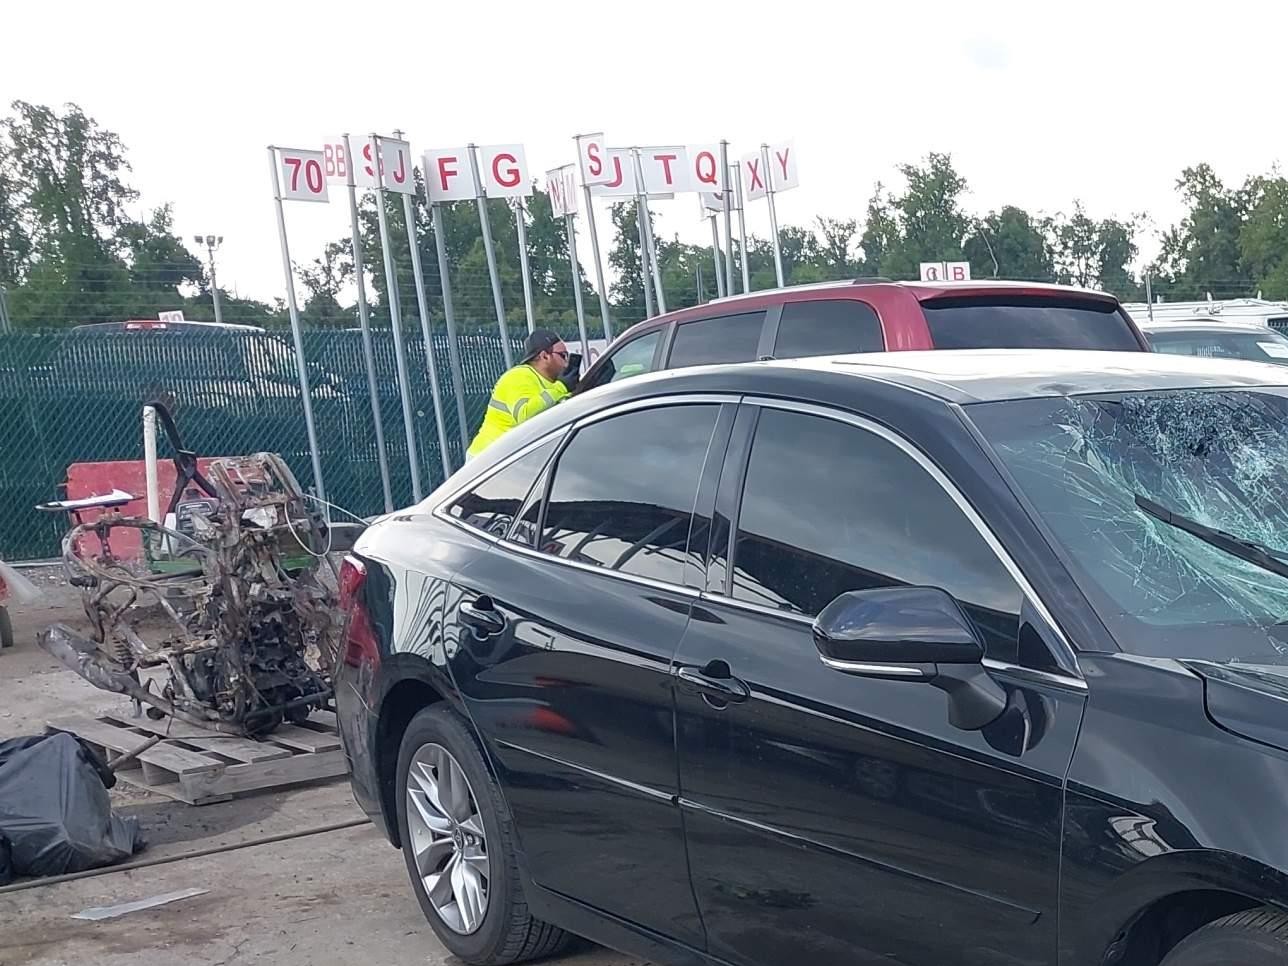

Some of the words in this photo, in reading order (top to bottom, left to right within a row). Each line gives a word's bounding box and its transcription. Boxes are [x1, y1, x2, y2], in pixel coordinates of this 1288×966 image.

[284, 157, 323, 194] 70
[324, 144, 347, 177] BB
[393, 149, 405, 183] J
[438, 157, 458, 191] F
[492, 153, 521, 188] G
[587, 142, 602, 176] S
[604, 156, 623, 188] J
[654, 154, 677, 185] T
[695, 151, 717, 186] Q
[747, 158, 764, 192] X
[776, 147, 790, 181] Y
[953, 266, 965, 281] B
